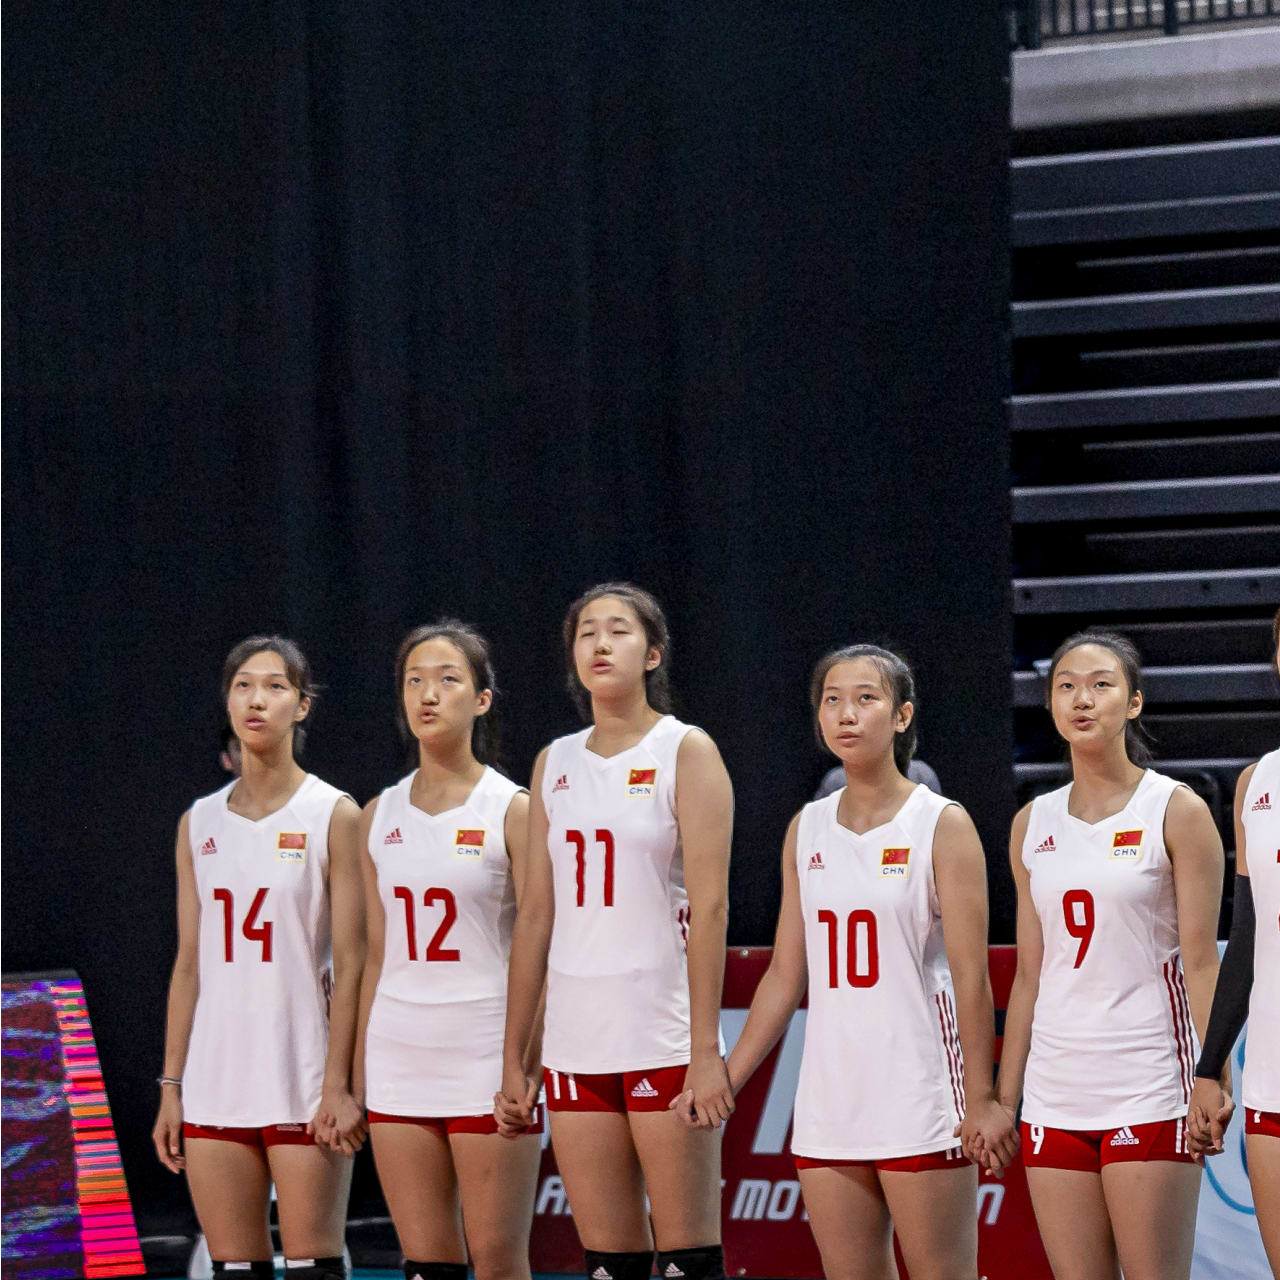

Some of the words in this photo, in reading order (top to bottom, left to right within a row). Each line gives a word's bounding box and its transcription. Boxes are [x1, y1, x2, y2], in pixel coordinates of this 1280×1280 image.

[629, 786, 651, 795] CHN
[280, 851, 303, 860] CHN
[457, 847, 480, 857] CHN
[1113, 847, 1137, 857] CHN
[565, 829, 615, 907] 11
[882, 866, 905, 876] CHN
[214, 887, 273, 962] 14
[394, 886, 461, 961] 12
[1062, 889, 1094, 969] 9
[818, 909, 879, 988] 10
[1030, 1124, 1045, 1155] 9
[1110, 1137, 1140, 1147] adidas
